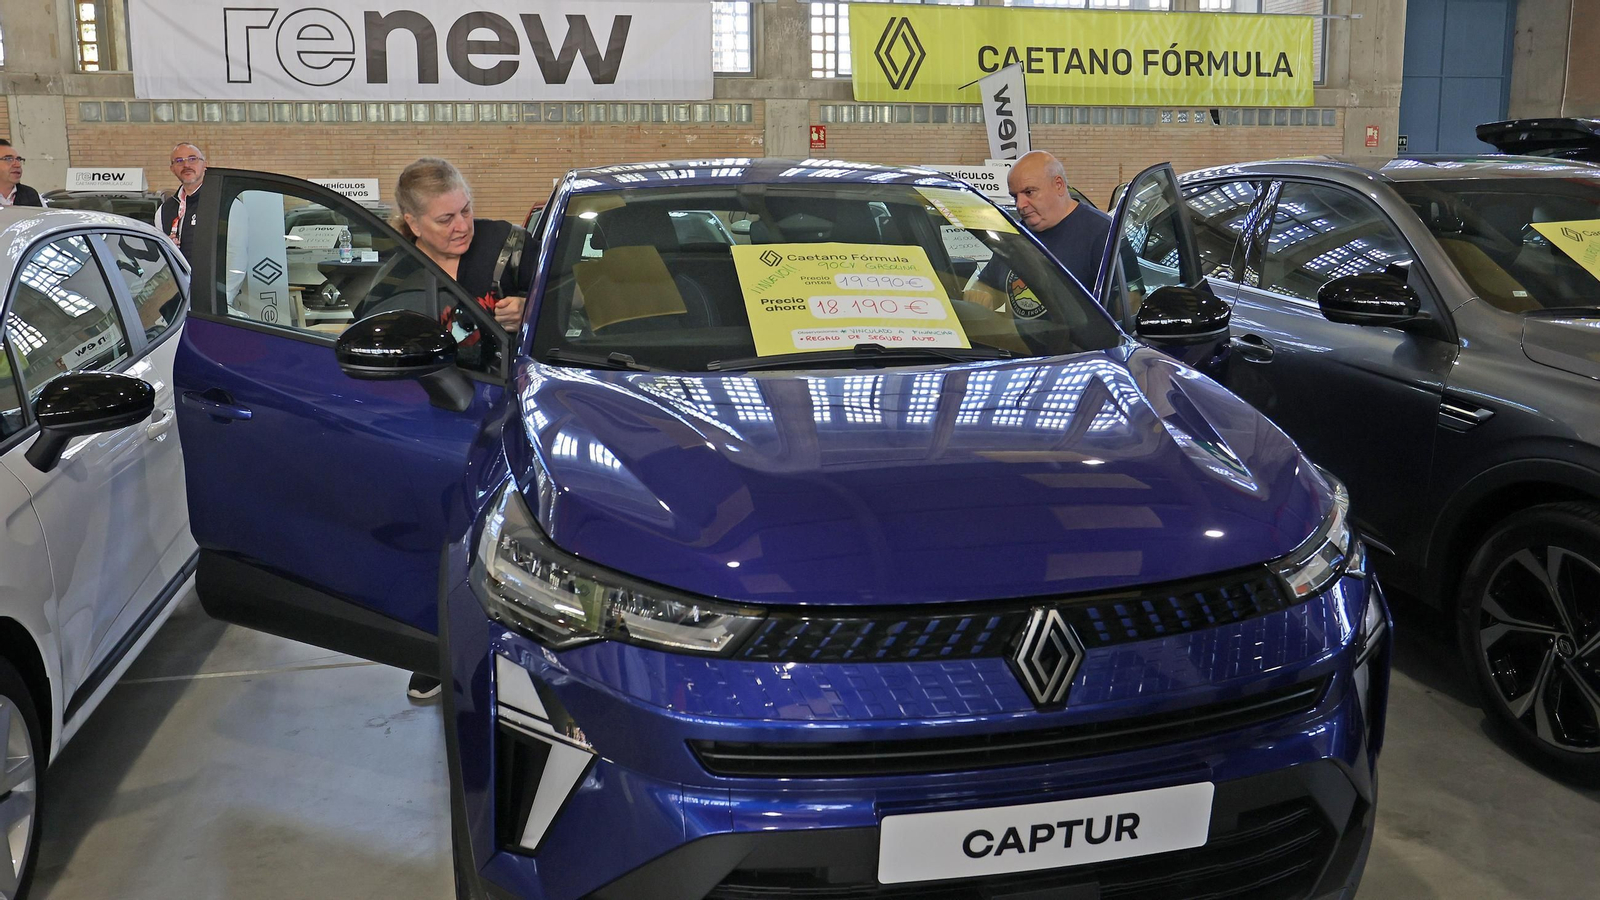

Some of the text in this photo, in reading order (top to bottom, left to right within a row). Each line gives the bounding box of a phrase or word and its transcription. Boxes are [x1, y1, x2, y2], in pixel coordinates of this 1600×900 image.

[223, 7, 632, 87] renew
[978, 42, 1294, 78] CAETANO FÓRMULA
[75, 171, 126, 181] renew
[947, 170, 995, 180] HÍCULOS
[787, 253, 909, 263] Caetano Fórmula
[817, 261, 856, 270] 90CV
[760, 296, 805, 305] Precio
[765, 304, 807, 312] ahora
[962, 812, 1140, 859] CAPTUR
